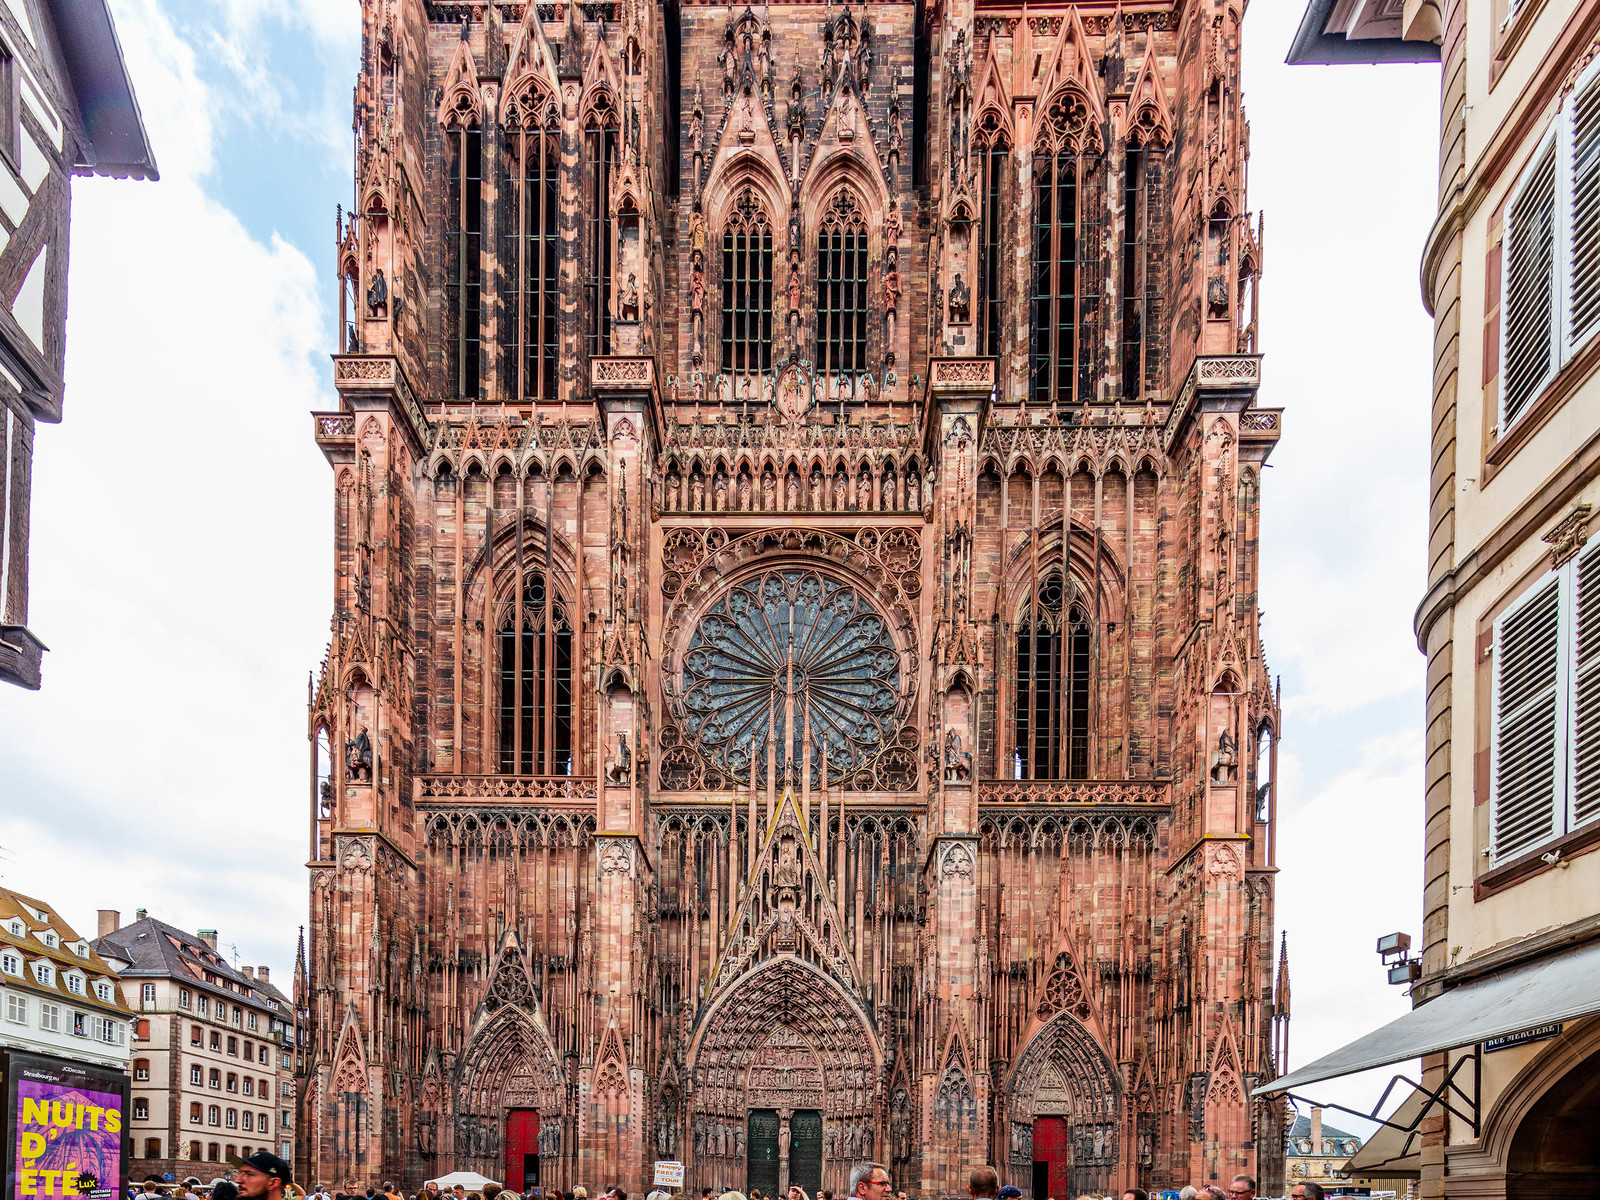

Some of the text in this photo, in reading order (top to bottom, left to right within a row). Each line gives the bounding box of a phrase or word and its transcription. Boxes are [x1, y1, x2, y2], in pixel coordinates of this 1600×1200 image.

[1488, 1037, 1505, 1046] RUE
[61, 1066, 87, 1075] JCDecaux
[23, 1070, 60, 1082] Strasbourg.eu
[22, 1097, 121, 1133] NUITS
[20, 1159, 79, 1196] ÉTÉ
[78, 1180, 96, 1188] LuX
